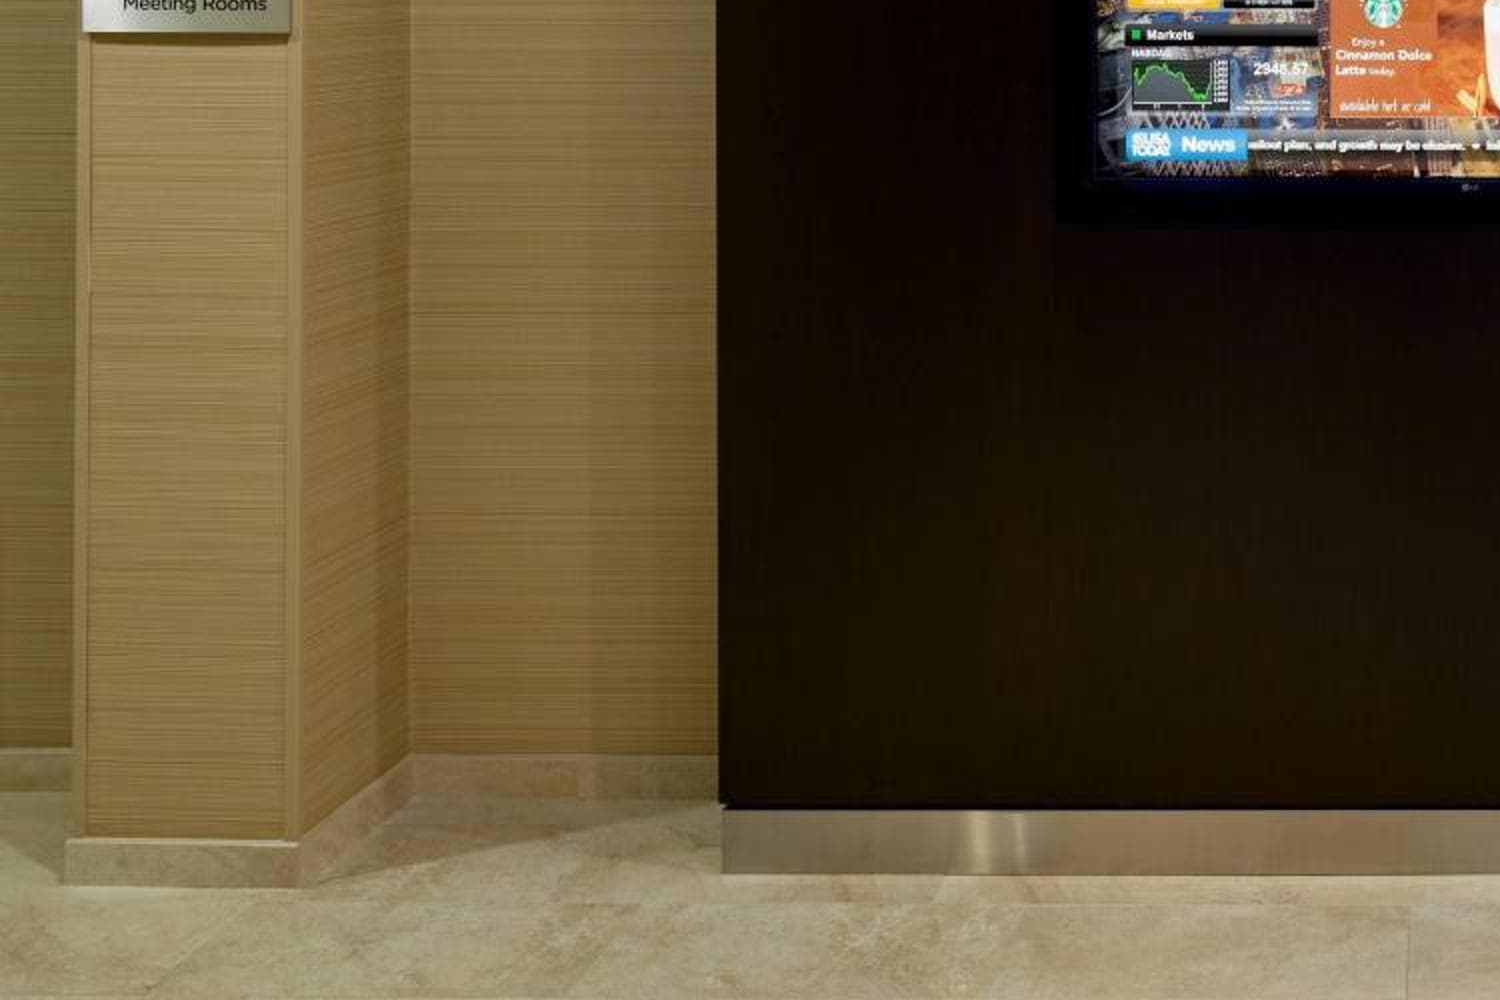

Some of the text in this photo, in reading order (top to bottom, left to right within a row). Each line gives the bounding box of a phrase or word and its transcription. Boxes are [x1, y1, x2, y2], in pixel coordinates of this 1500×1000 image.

[1147, 29, 1194, 41] Markets
[1352, 37, 1377, 49] Enjoy
[1335, 49, 1434, 61] Cinnamon Dolce
[1335, 64, 1366, 76] Latte
[1181, 136, 1236, 153] News
[1315, 140, 1337, 151] and
[1380, 142, 1402, 153] may
[1405, 140, 1420, 151] be
